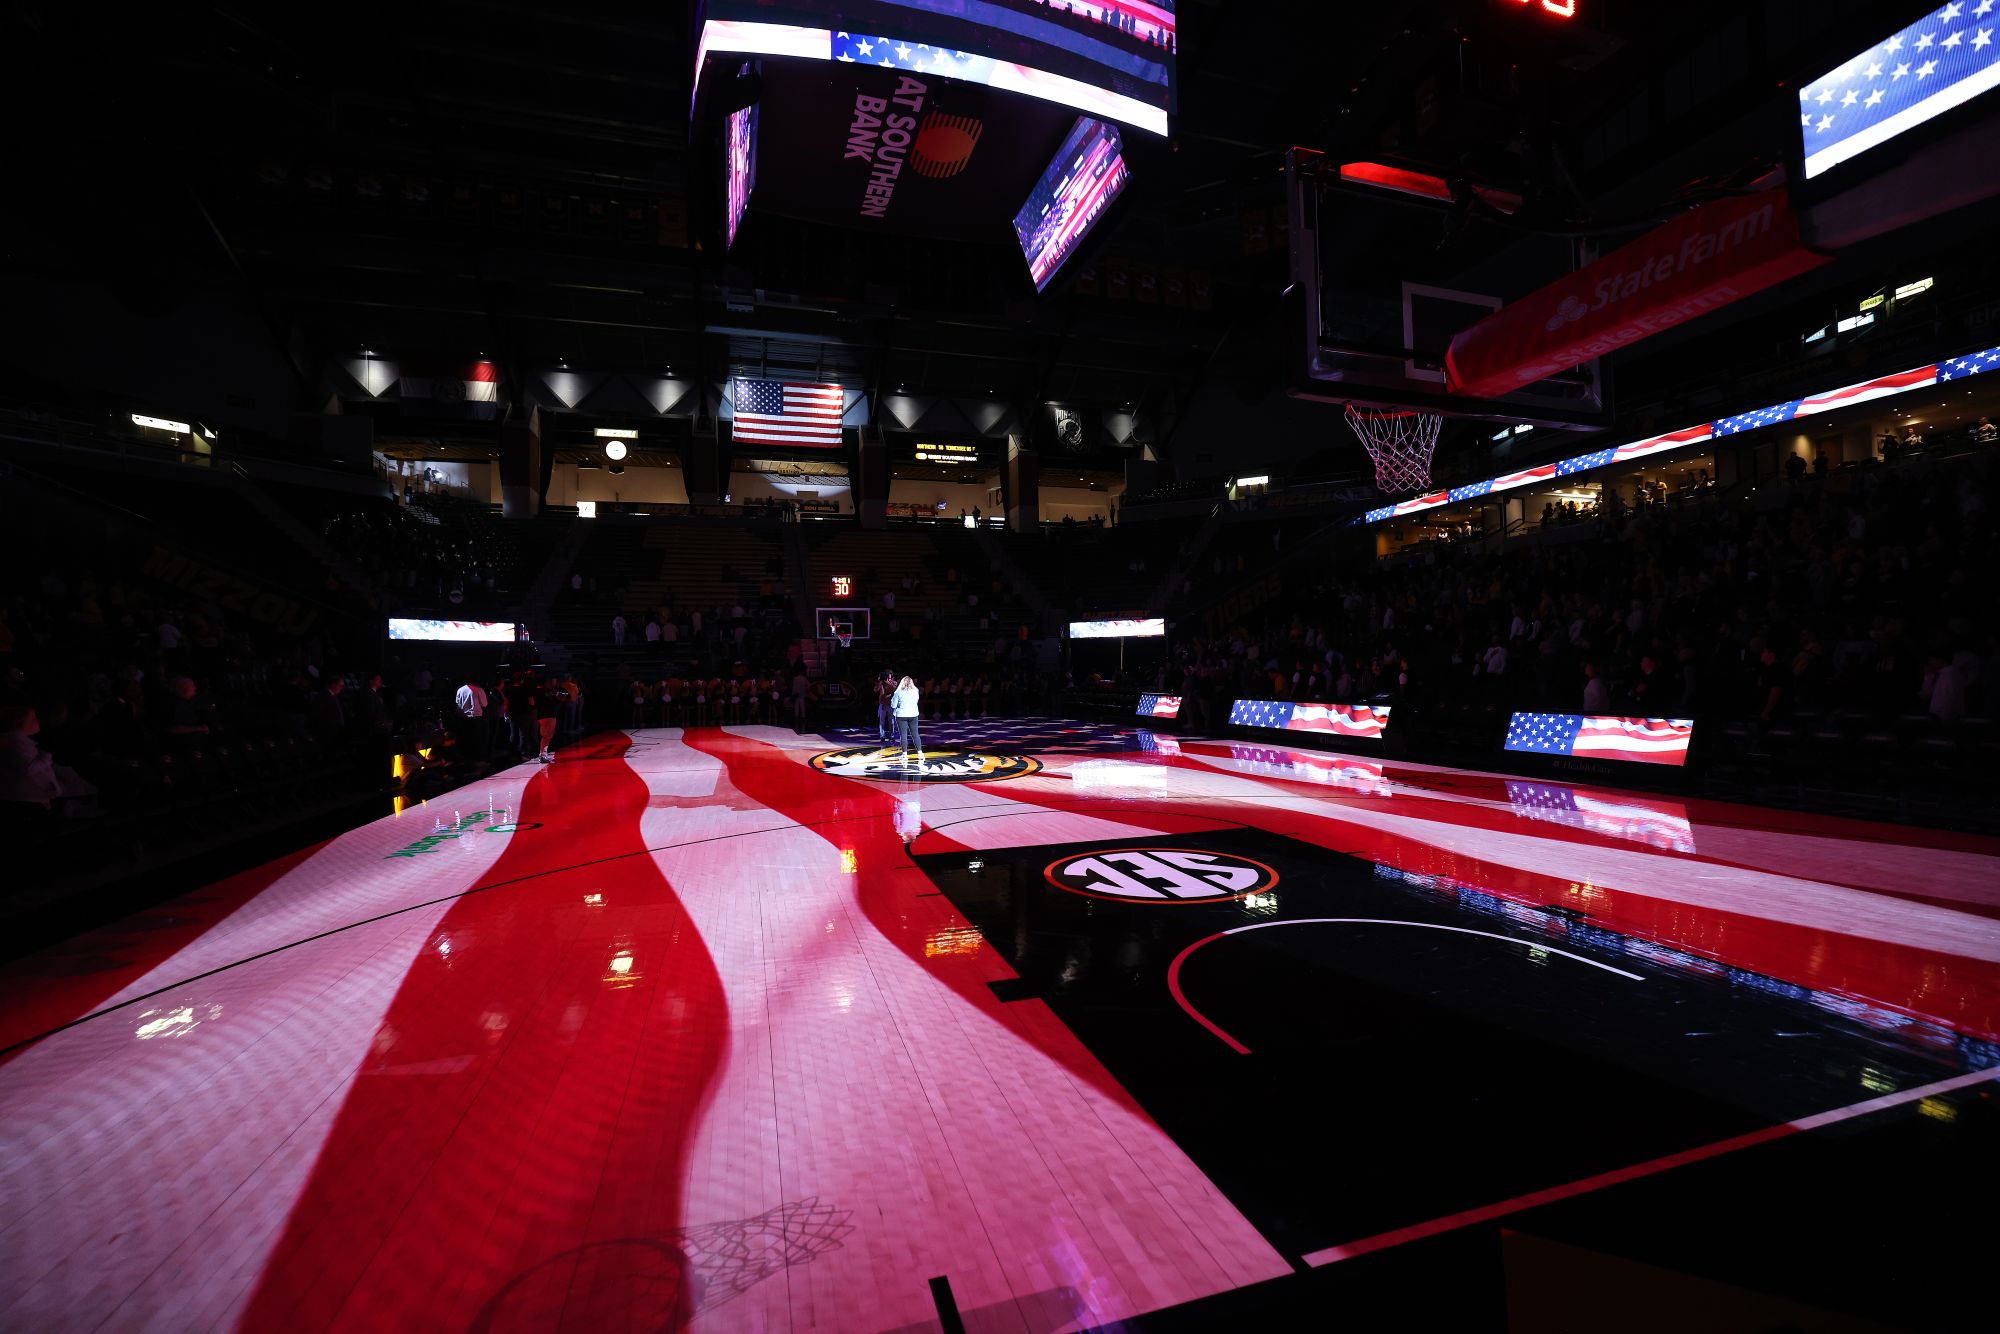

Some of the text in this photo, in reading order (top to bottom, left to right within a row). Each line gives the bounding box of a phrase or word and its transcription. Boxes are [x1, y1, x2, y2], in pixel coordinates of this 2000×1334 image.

[843, 94, 888, 163] BANK
[860, 113, 917, 218] SOUTHERN
[834, 583, 849, 595] 30
[1063, 851, 1259, 899] SEC
